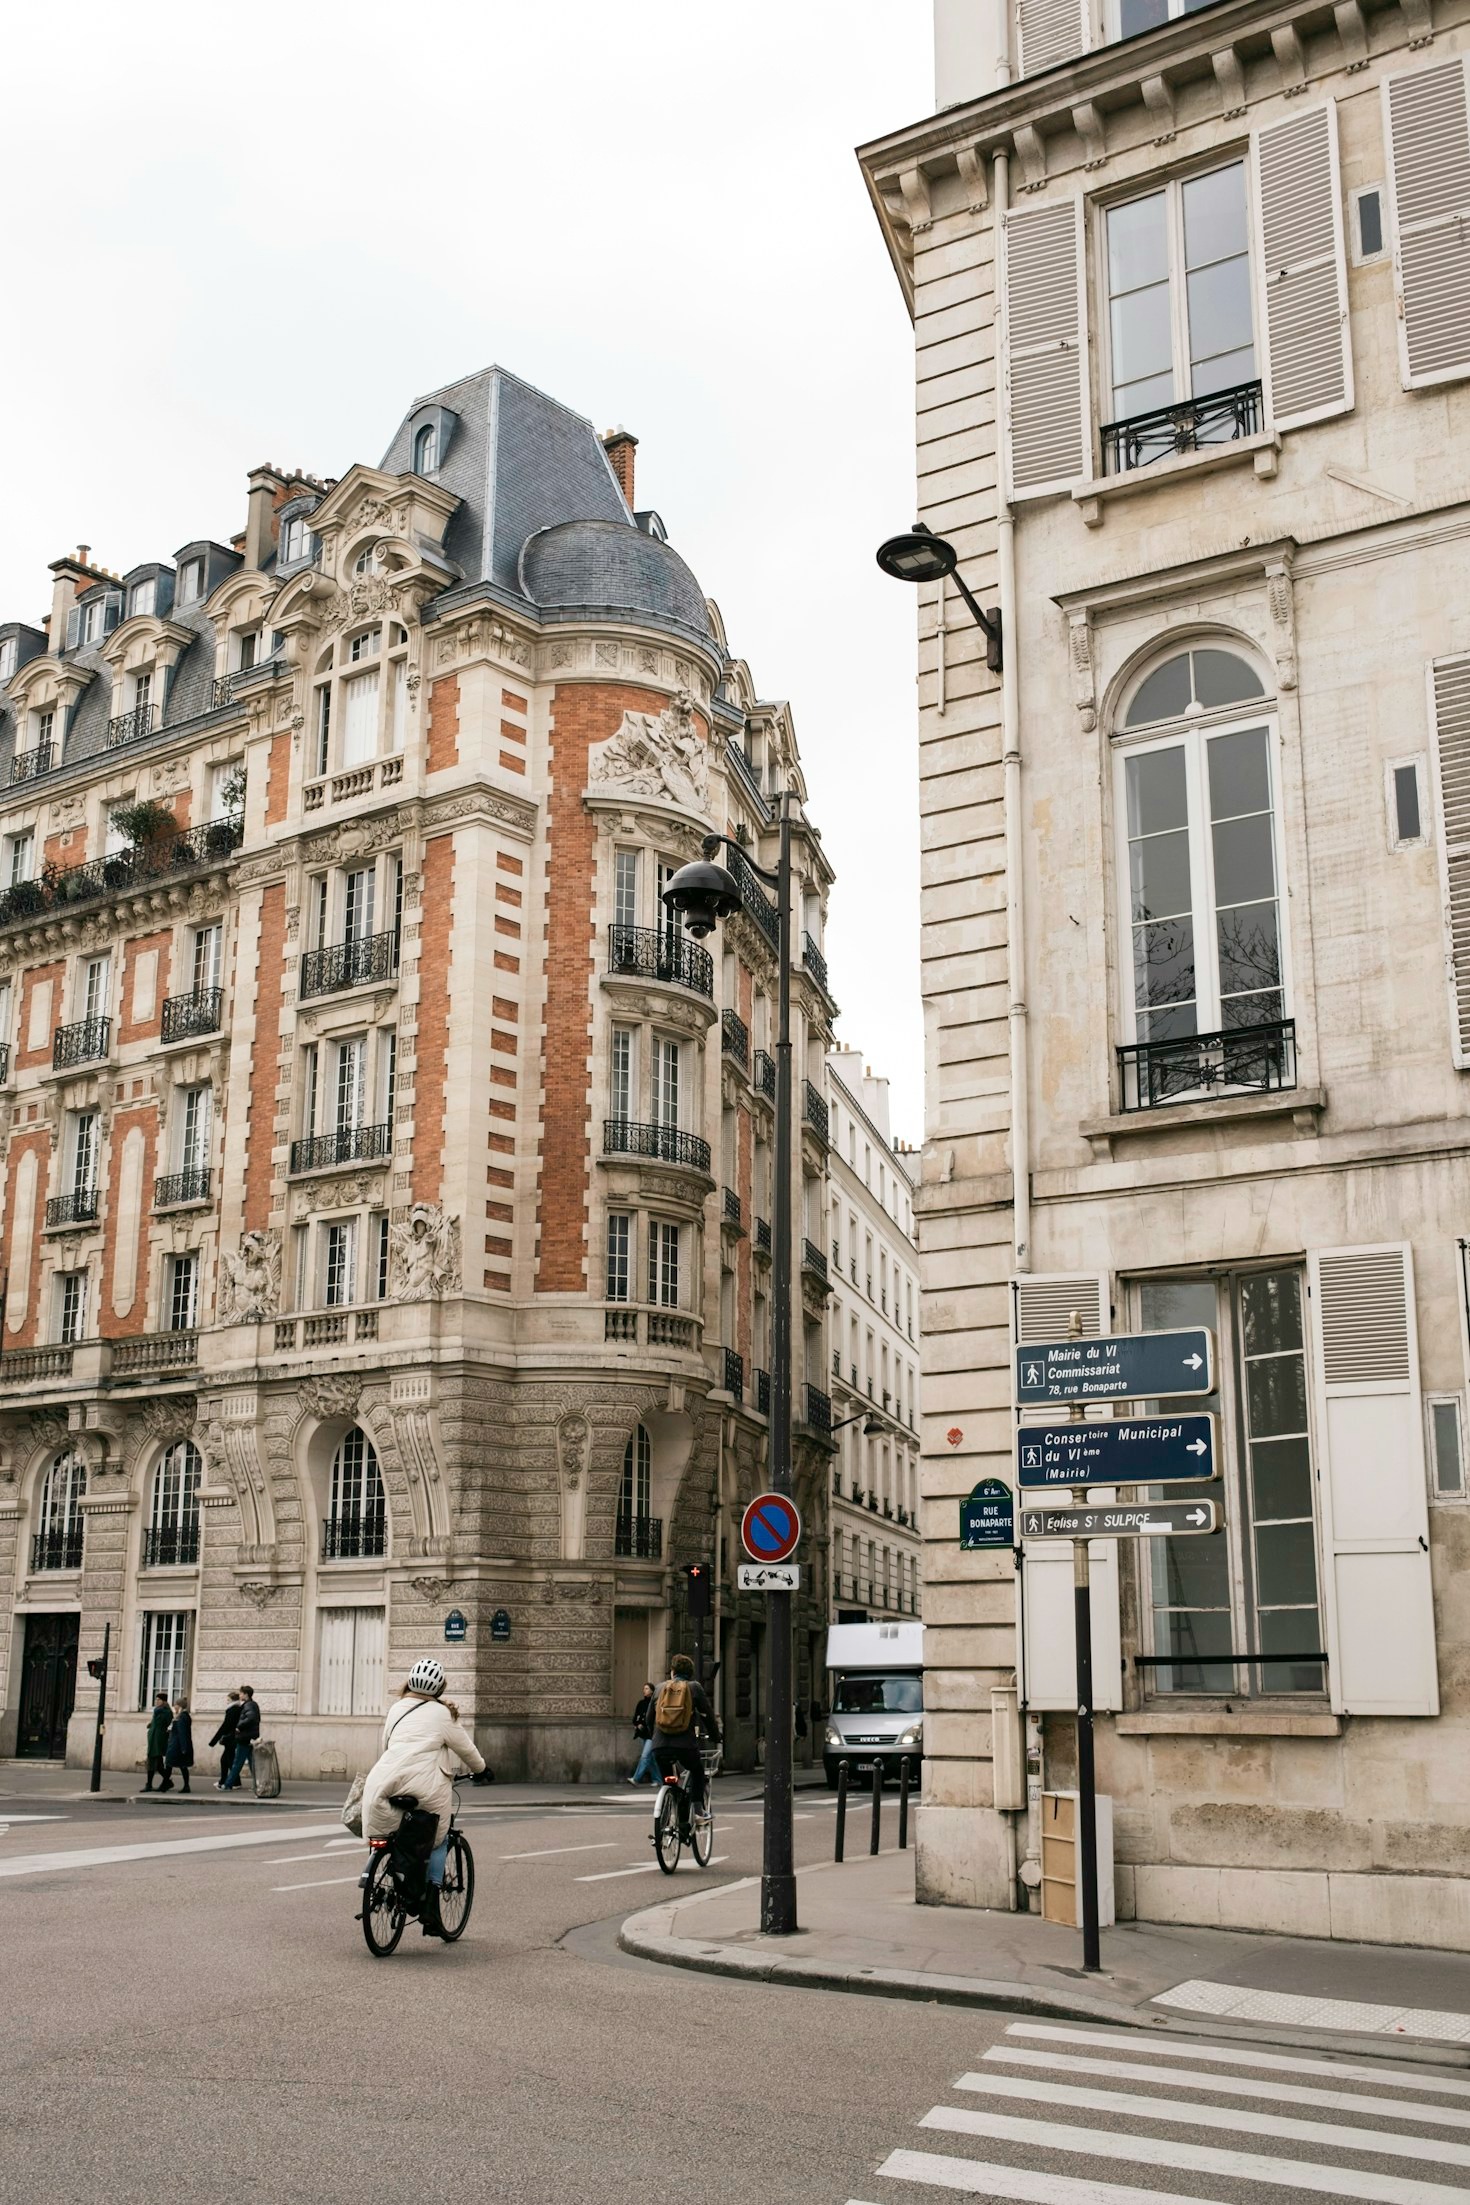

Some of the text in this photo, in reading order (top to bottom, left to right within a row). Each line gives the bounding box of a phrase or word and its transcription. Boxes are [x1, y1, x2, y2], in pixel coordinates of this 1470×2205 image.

[1048, 1344, 1117, 1362] Mairie du VI
[1048, 1362, 1121, 1379] Commissariat
[1048, 1381, 1128, 1396] 78, rue Bonaparte
[1118, 1424, 1182, 1441] Municipal
[1045, 1450, 1060, 1462] du
[1045, 1465, 1090, 1480] (Mairie)
[984, 1506, 998, 1516] RUE
[970, 1518, 1012, 1528] BONAPARTE
[1103, 1512, 1151, 1527] SULPICE
